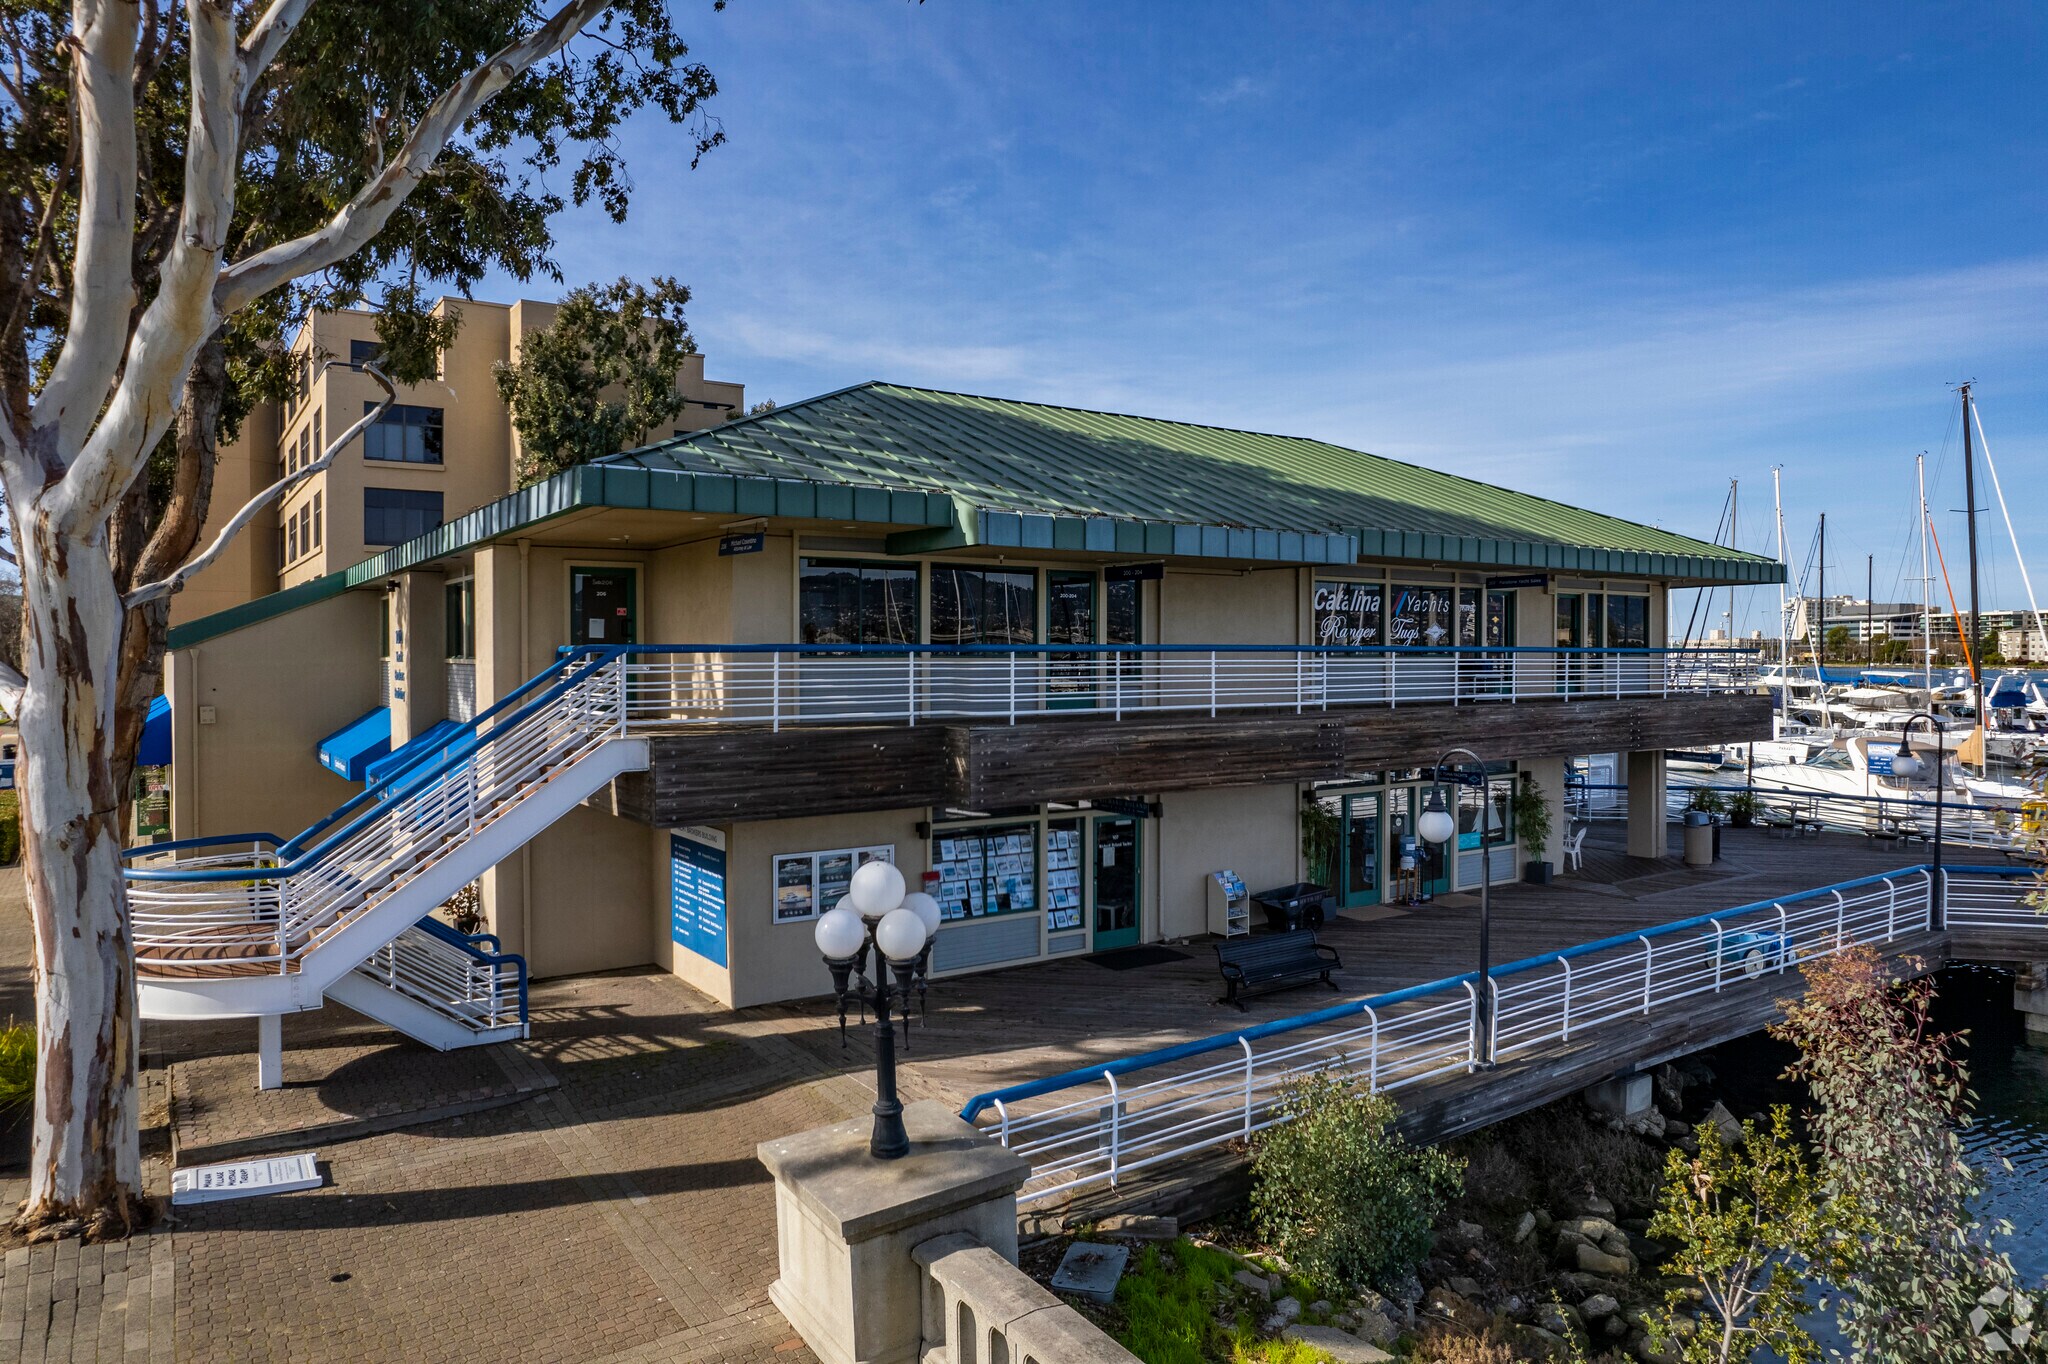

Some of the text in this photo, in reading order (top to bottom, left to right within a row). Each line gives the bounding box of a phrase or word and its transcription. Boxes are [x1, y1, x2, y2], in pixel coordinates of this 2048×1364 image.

[1314, 588, 1450, 613] Catalina Yachts
[1320, 615, 1376, 646] Ranger
[1390, 616, 1419, 646] Tugs
[216, 1171, 224, 1187] VILLAGE
